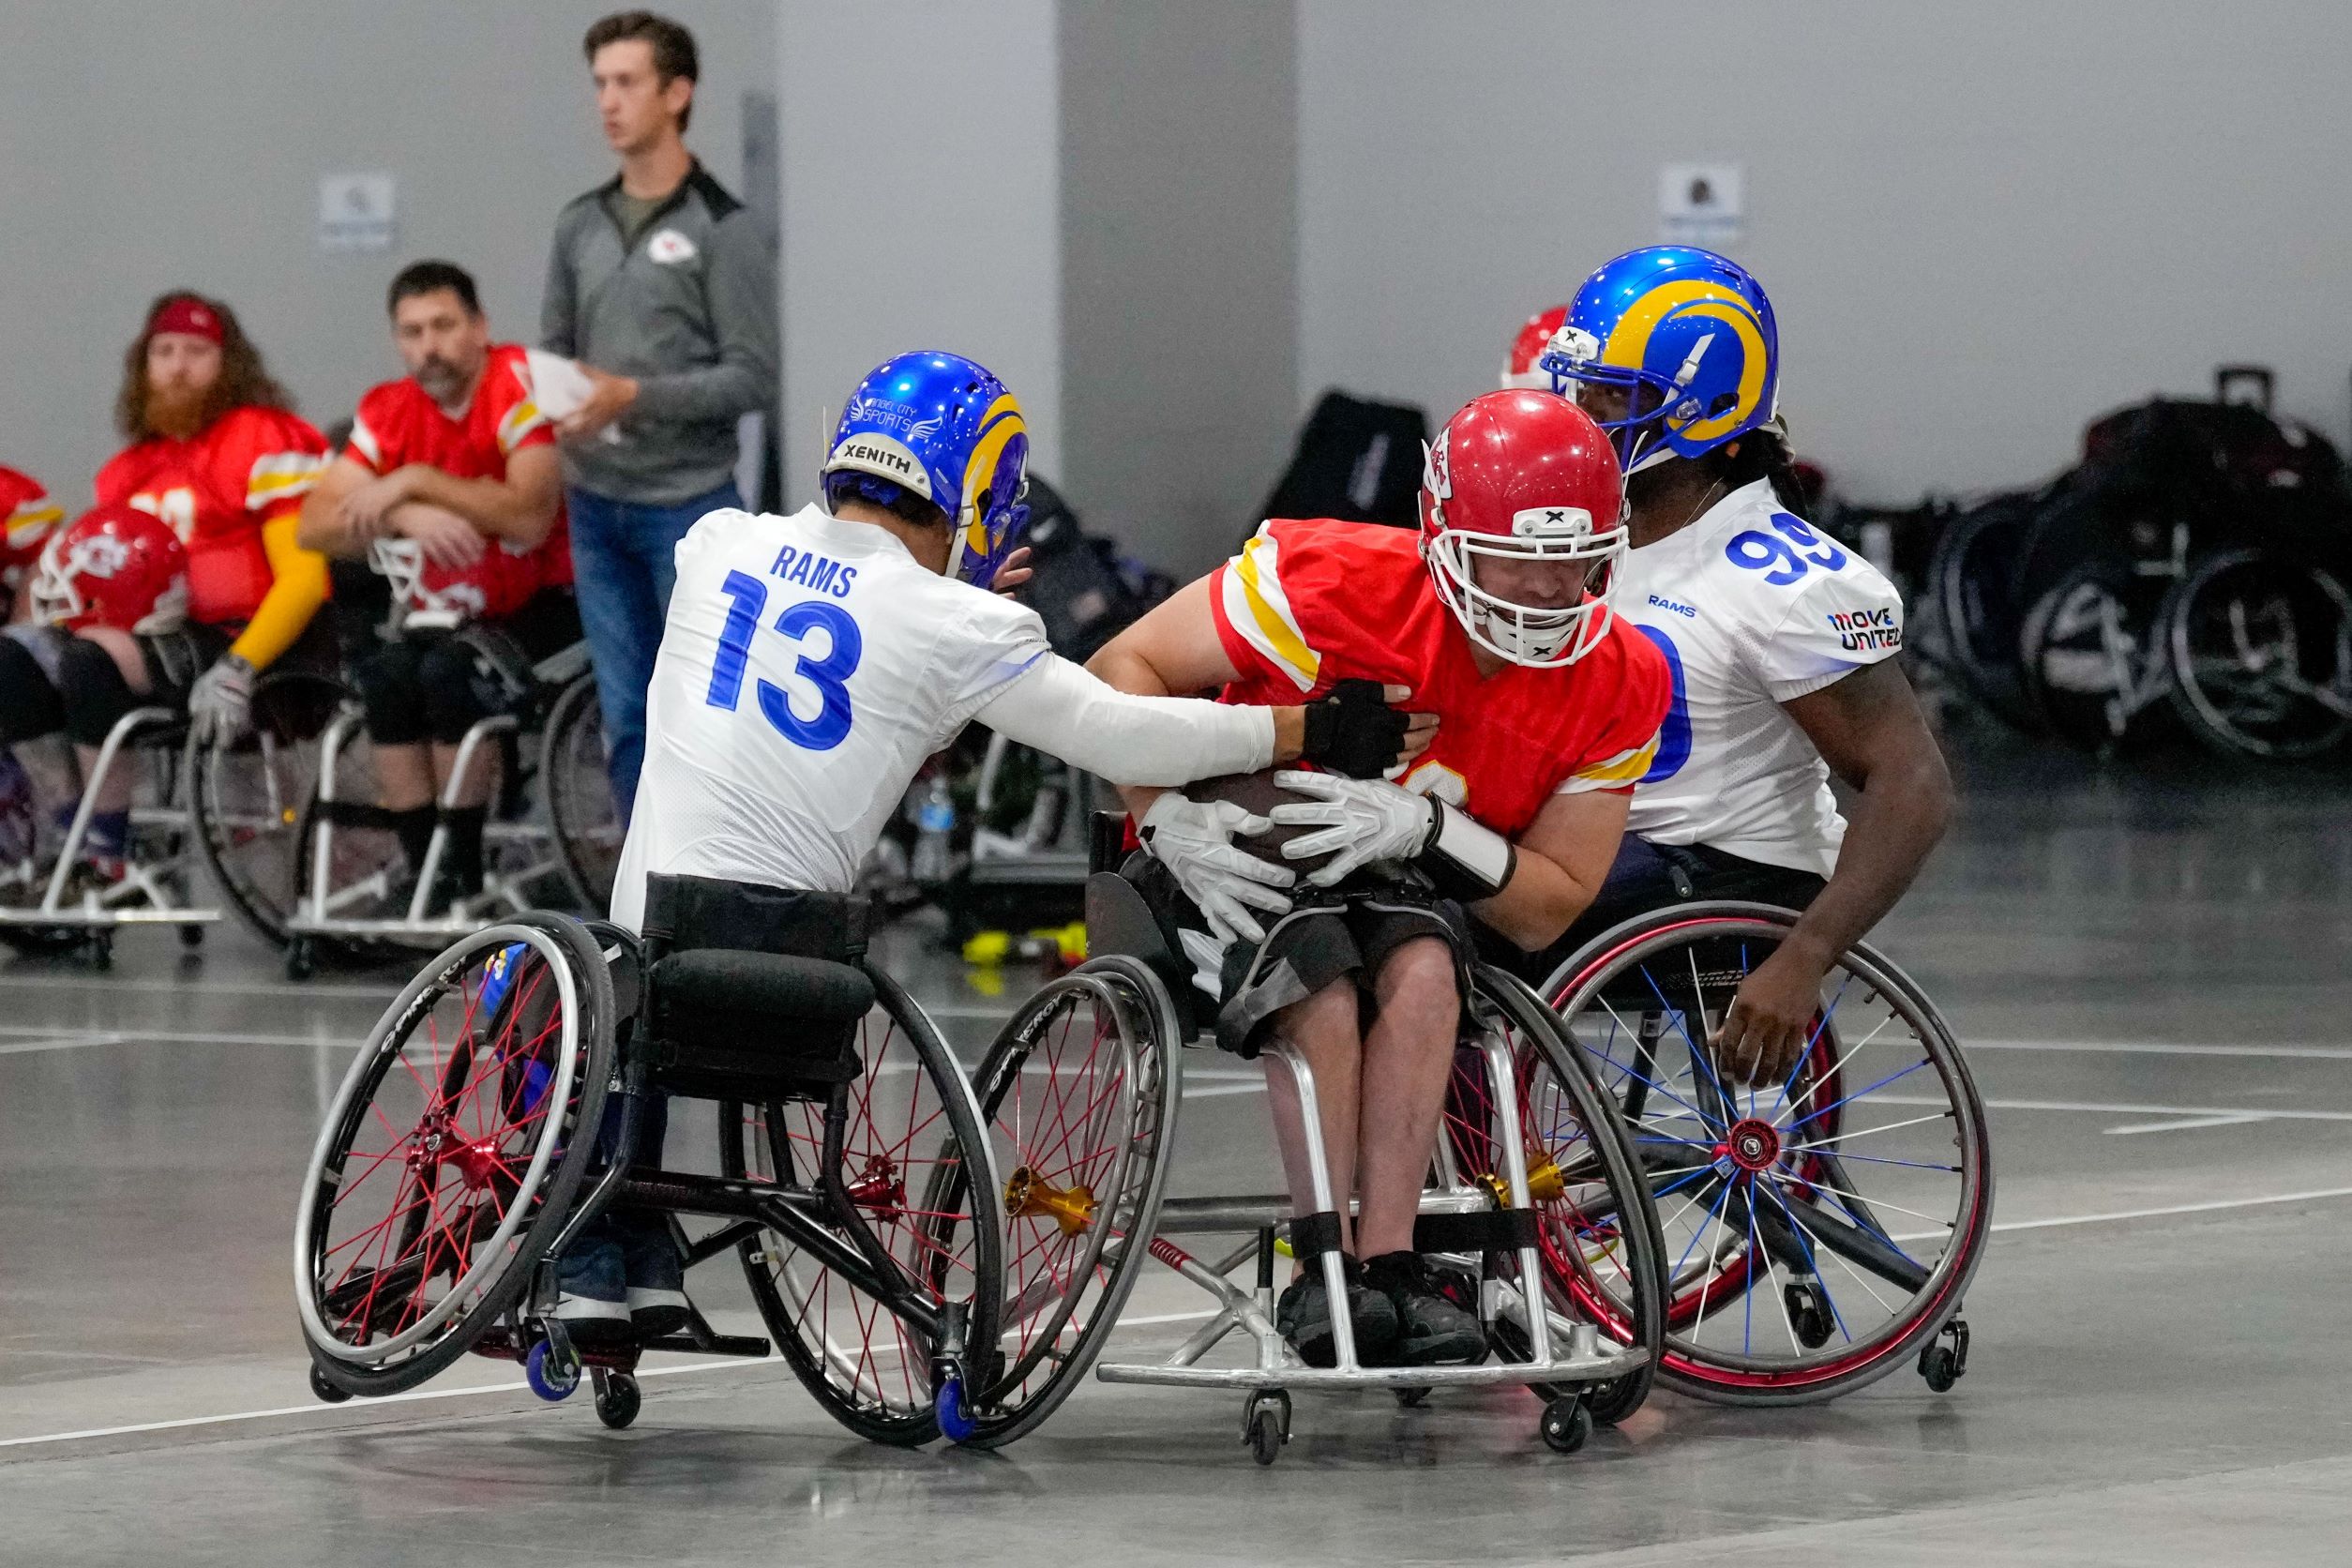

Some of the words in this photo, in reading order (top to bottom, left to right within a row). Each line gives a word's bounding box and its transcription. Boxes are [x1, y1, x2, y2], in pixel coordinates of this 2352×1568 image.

[862, 408, 912, 432] SPORTS
[897, 403, 917, 417] CITY
[844, 445, 912, 474] XENITH
[1726, 513, 1847, 586] 99
[769, 544, 858, 598] RAMS
[1648, 595, 1696, 618] RAMS
[1841, 626, 1902, 651] UNITED
[705, 569, 863, 751] 13
